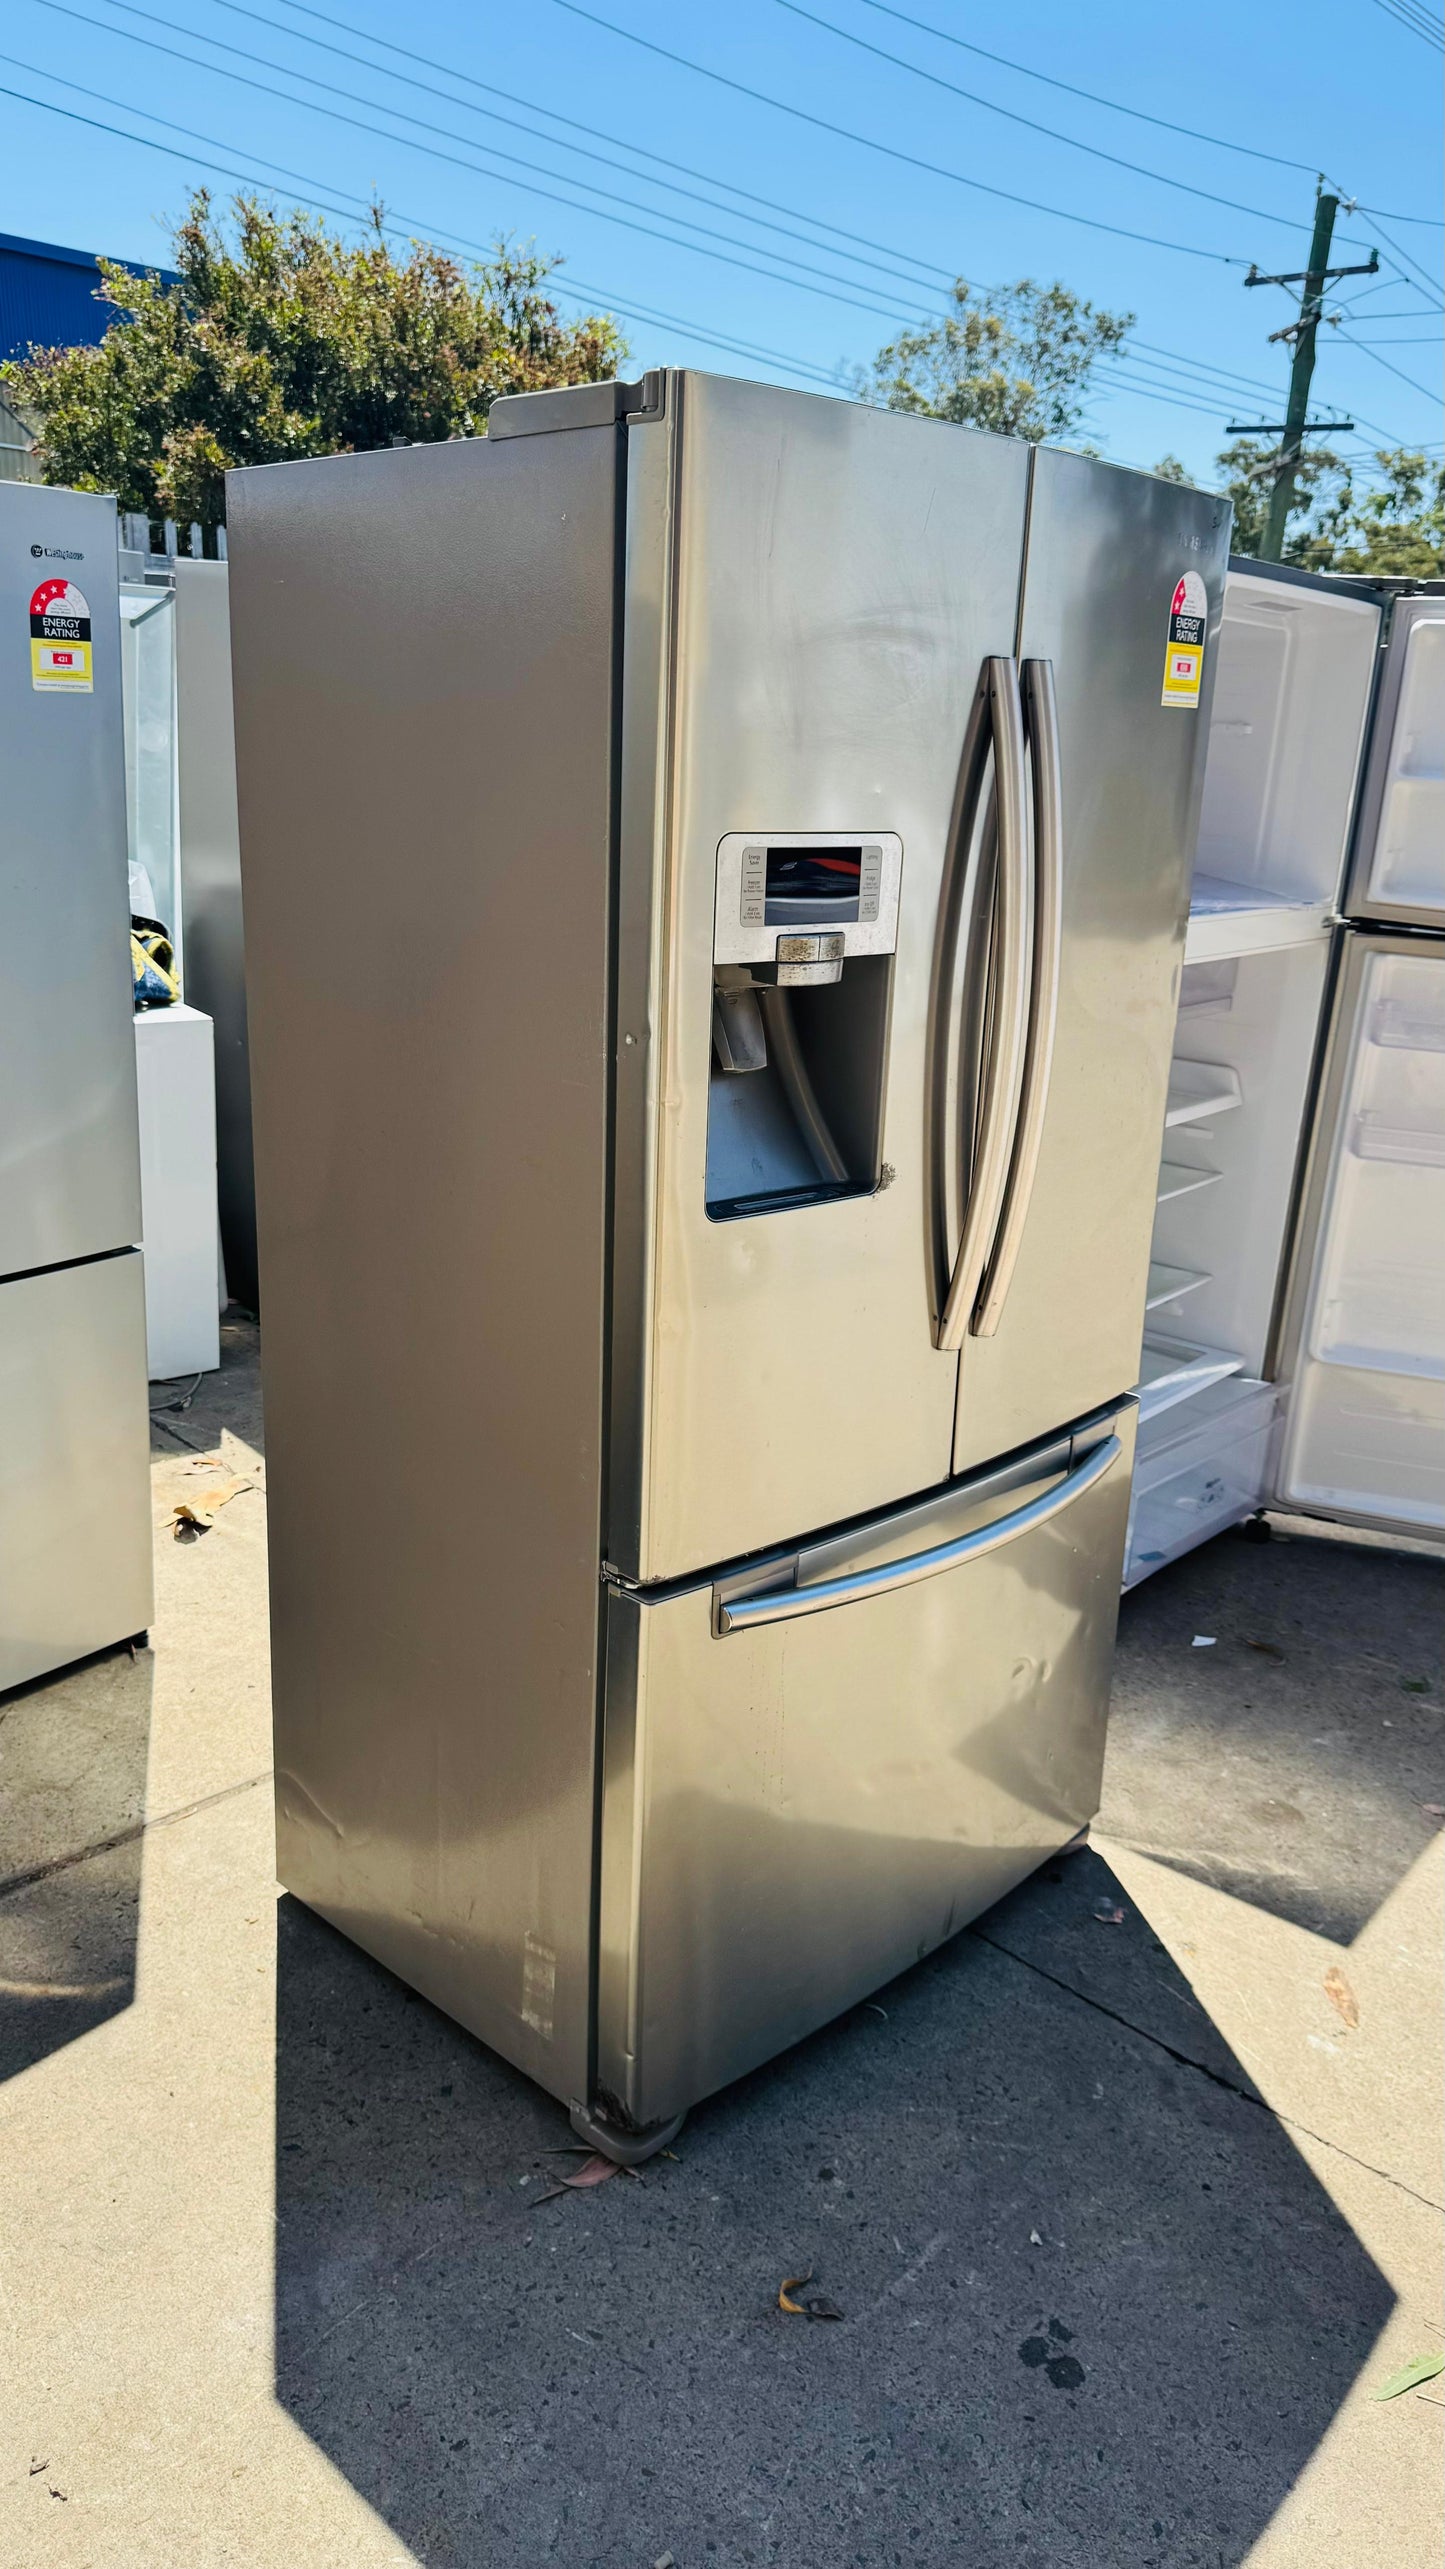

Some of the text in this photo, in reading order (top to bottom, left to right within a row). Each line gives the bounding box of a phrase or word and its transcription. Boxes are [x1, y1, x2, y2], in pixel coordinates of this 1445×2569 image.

[42, 617, 80, 628] ENERGY
[1175, 616, 1200, 631] ENERGY
[44, 627, 80, 639] RATING
[1175, 629, 1198, 643] RATING
